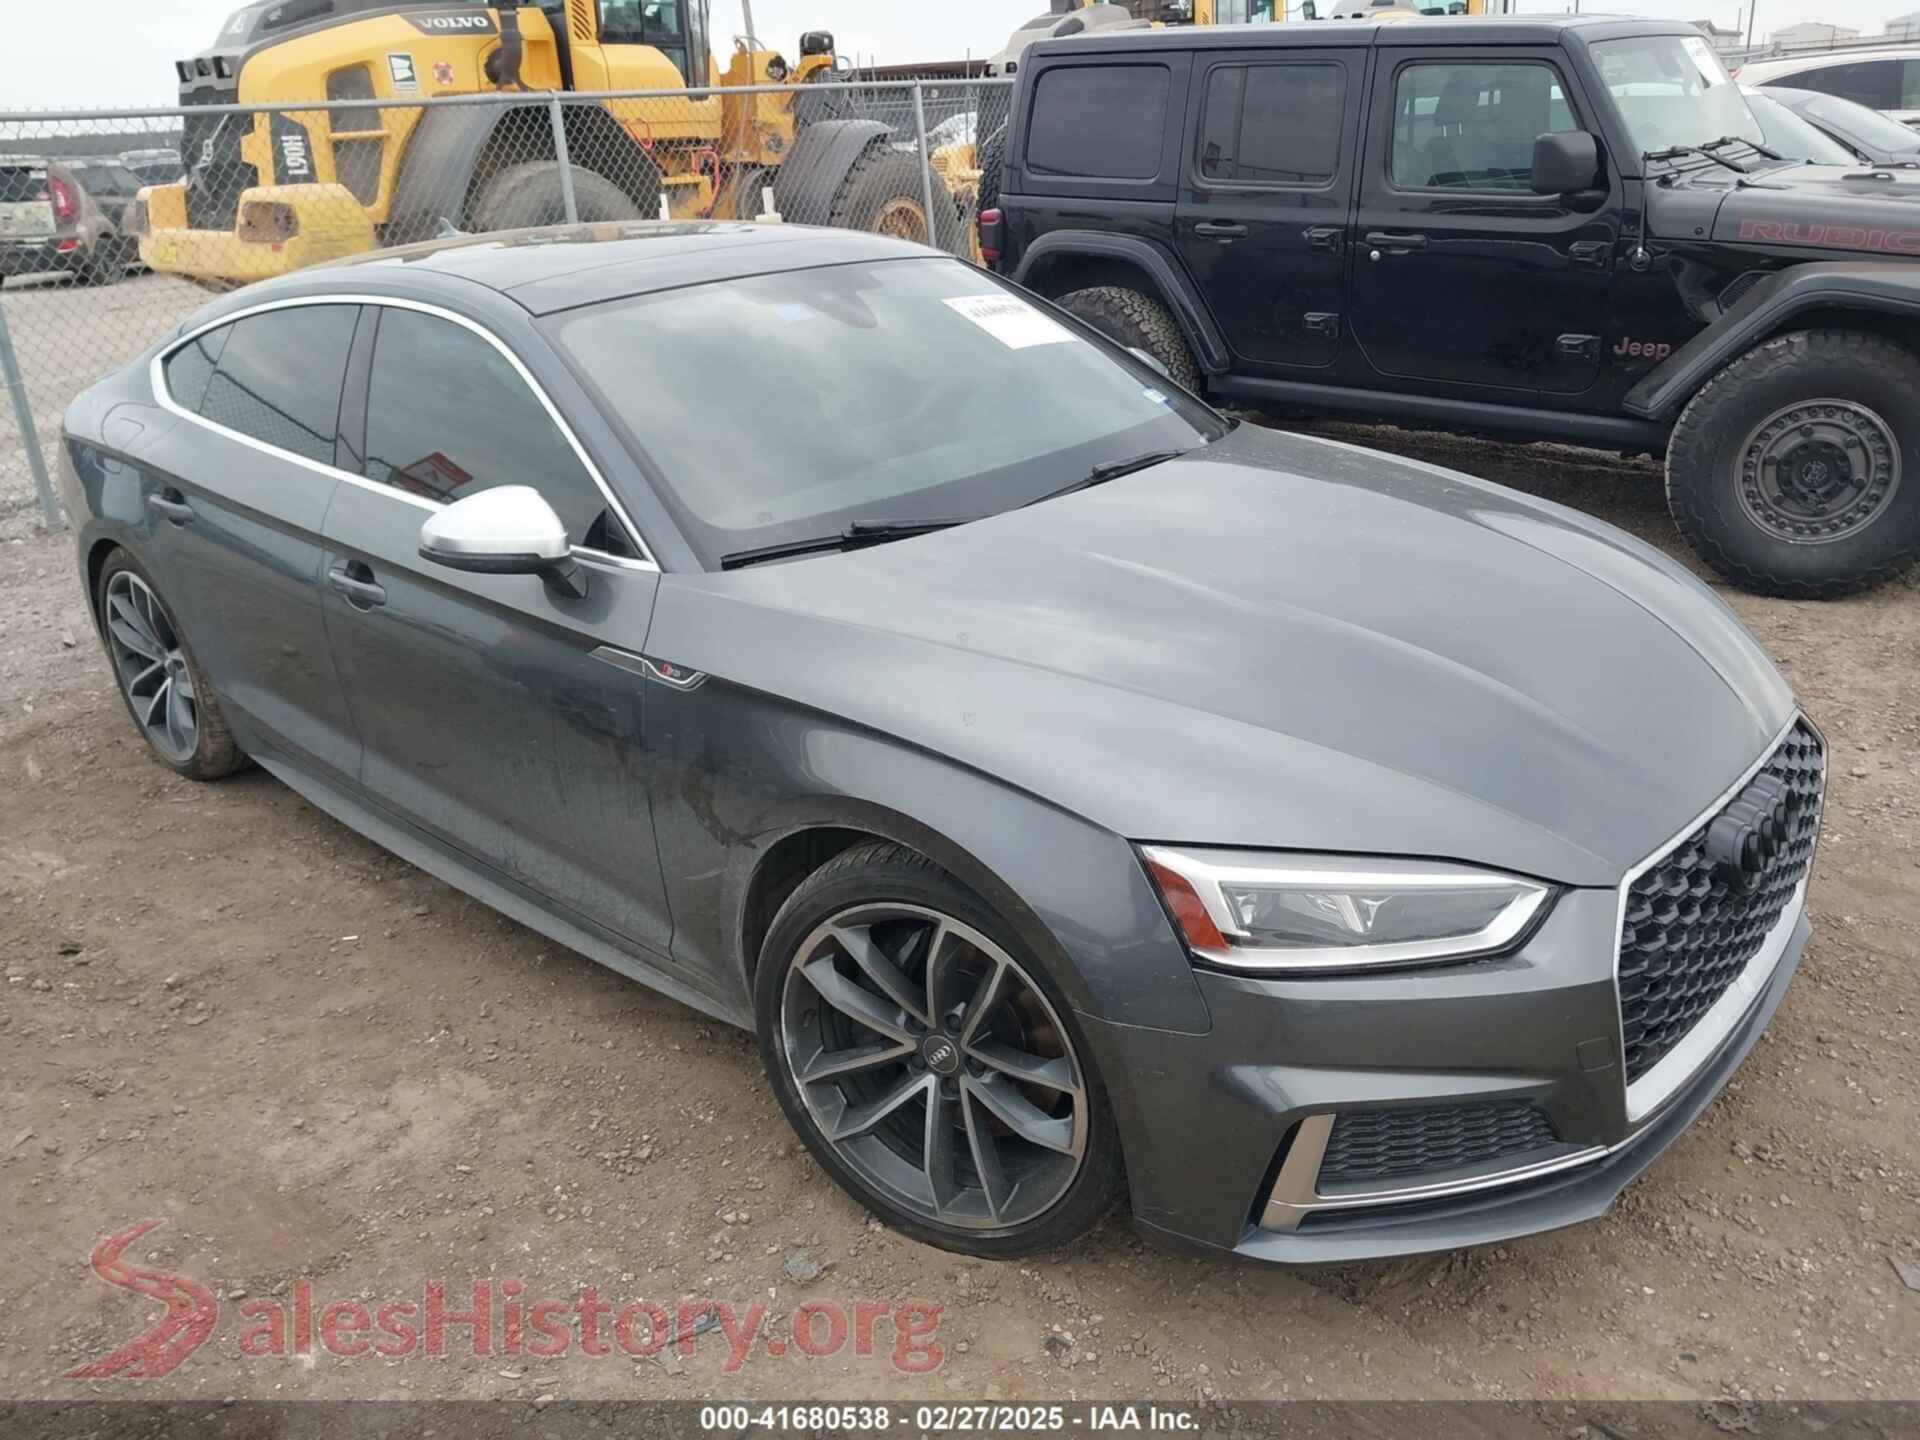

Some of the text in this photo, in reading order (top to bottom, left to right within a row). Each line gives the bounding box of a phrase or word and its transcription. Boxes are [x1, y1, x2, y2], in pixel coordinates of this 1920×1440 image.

[419, 16, 488, 28] VOLVO
[281, 135, 309, 175] L90H
[1613, 337, 1671, 360] Jeep
